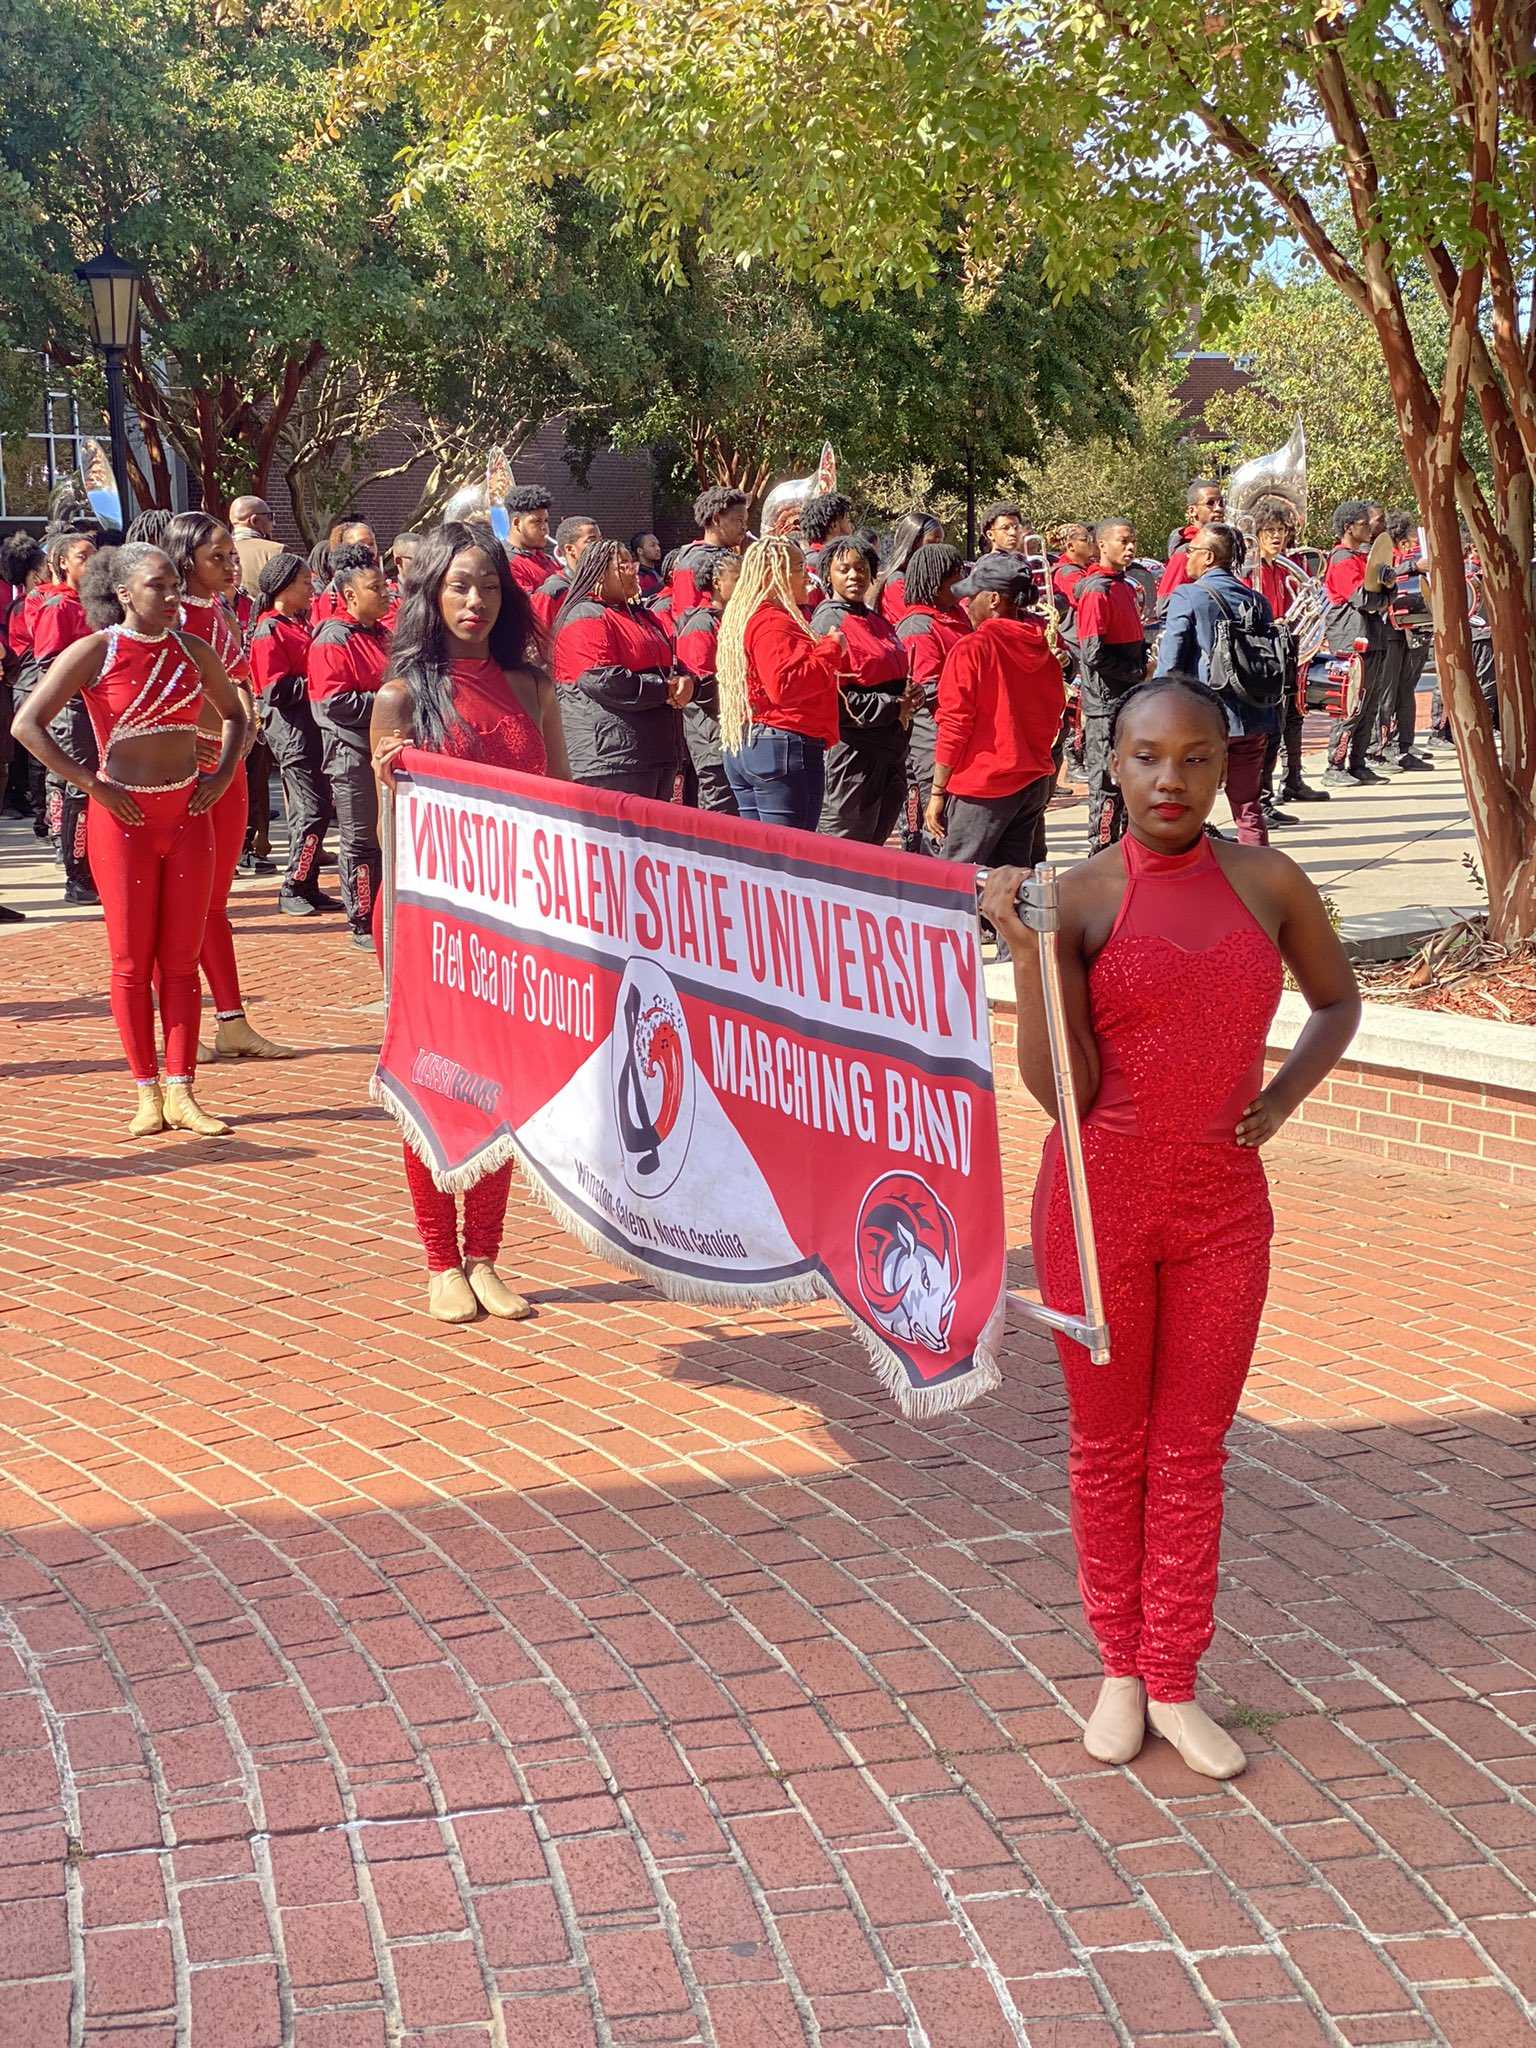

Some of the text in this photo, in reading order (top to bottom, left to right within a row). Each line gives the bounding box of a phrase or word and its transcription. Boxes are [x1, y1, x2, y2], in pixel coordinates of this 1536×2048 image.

[410, 797, 977, 1041] WINSTON-SALEM STATE UNIVERSITY
[432, 921, 595, 1043] Red Sea of Sound
[708, 1014, 973, 1178] MARCHING BAND
[574, 1157, 749, 1258] Winston-Salem, North Carolina
